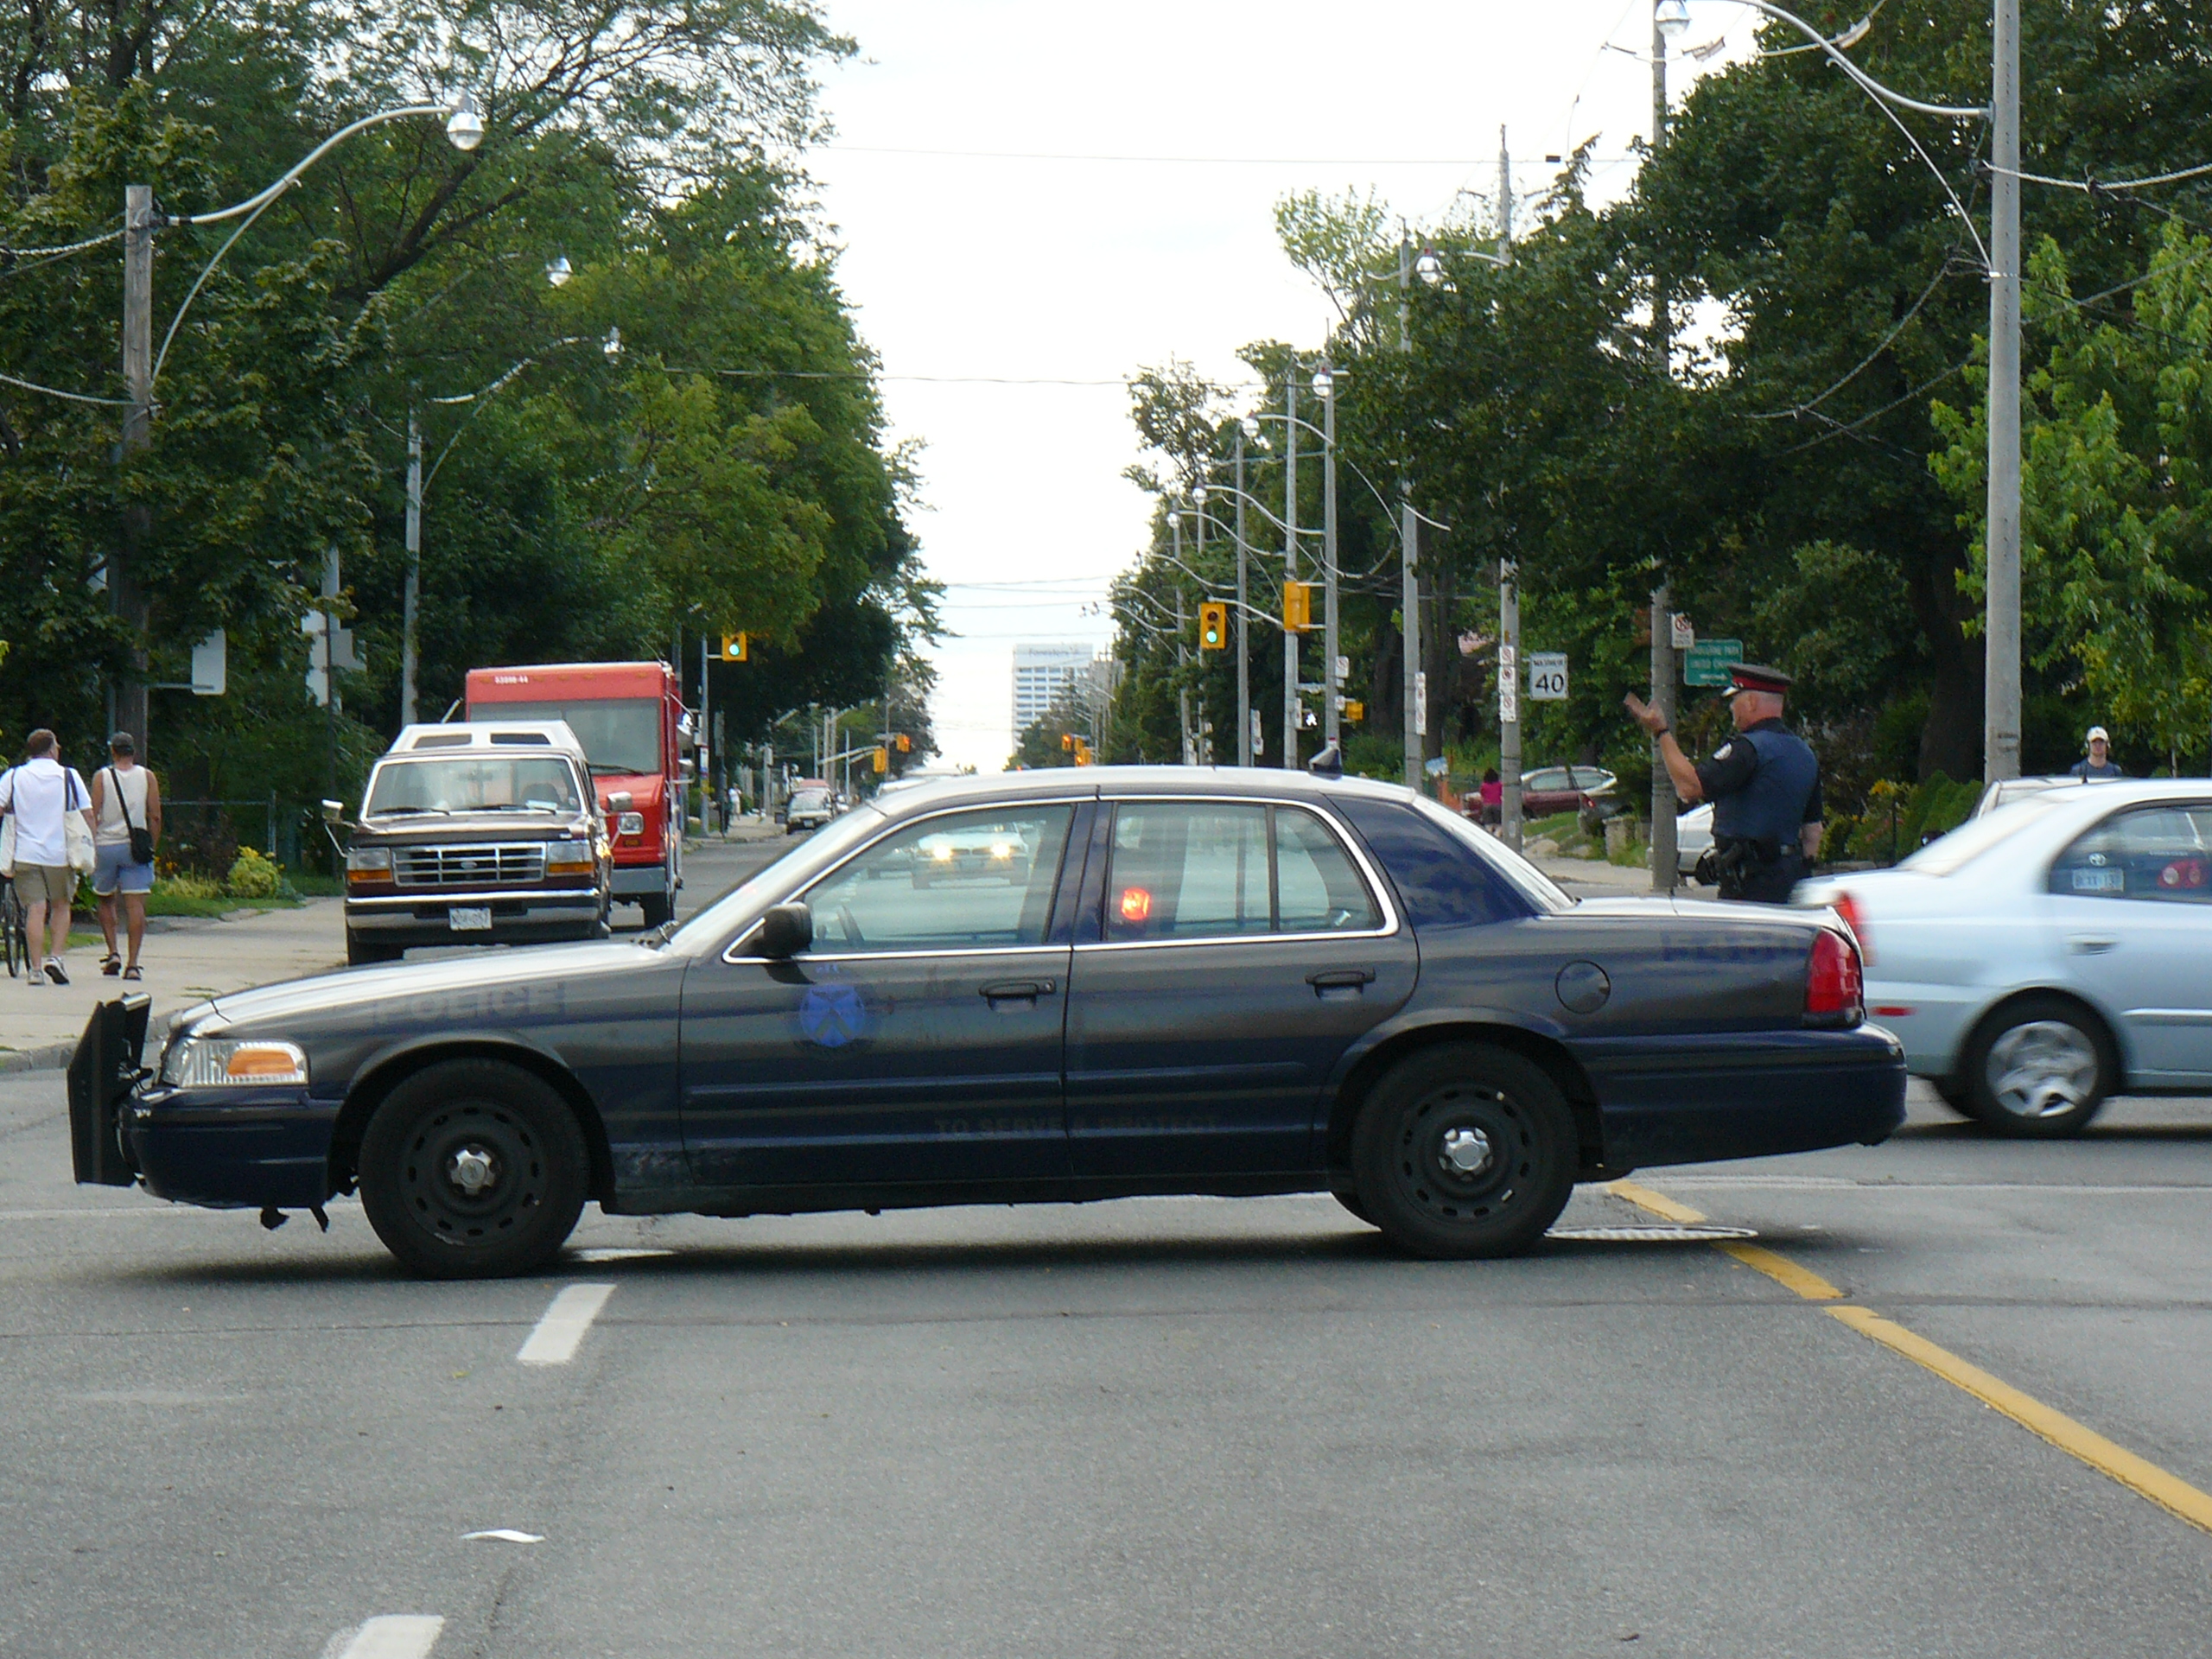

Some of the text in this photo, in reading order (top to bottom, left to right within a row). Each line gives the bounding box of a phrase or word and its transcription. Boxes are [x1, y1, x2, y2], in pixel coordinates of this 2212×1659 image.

[1535, 672, 1565, 694] 40
[373, 981, 567, 1027] POLICE
[934, 1119, 969, 1135] TO
[978, 1116, 1064, 1134] SERVE
